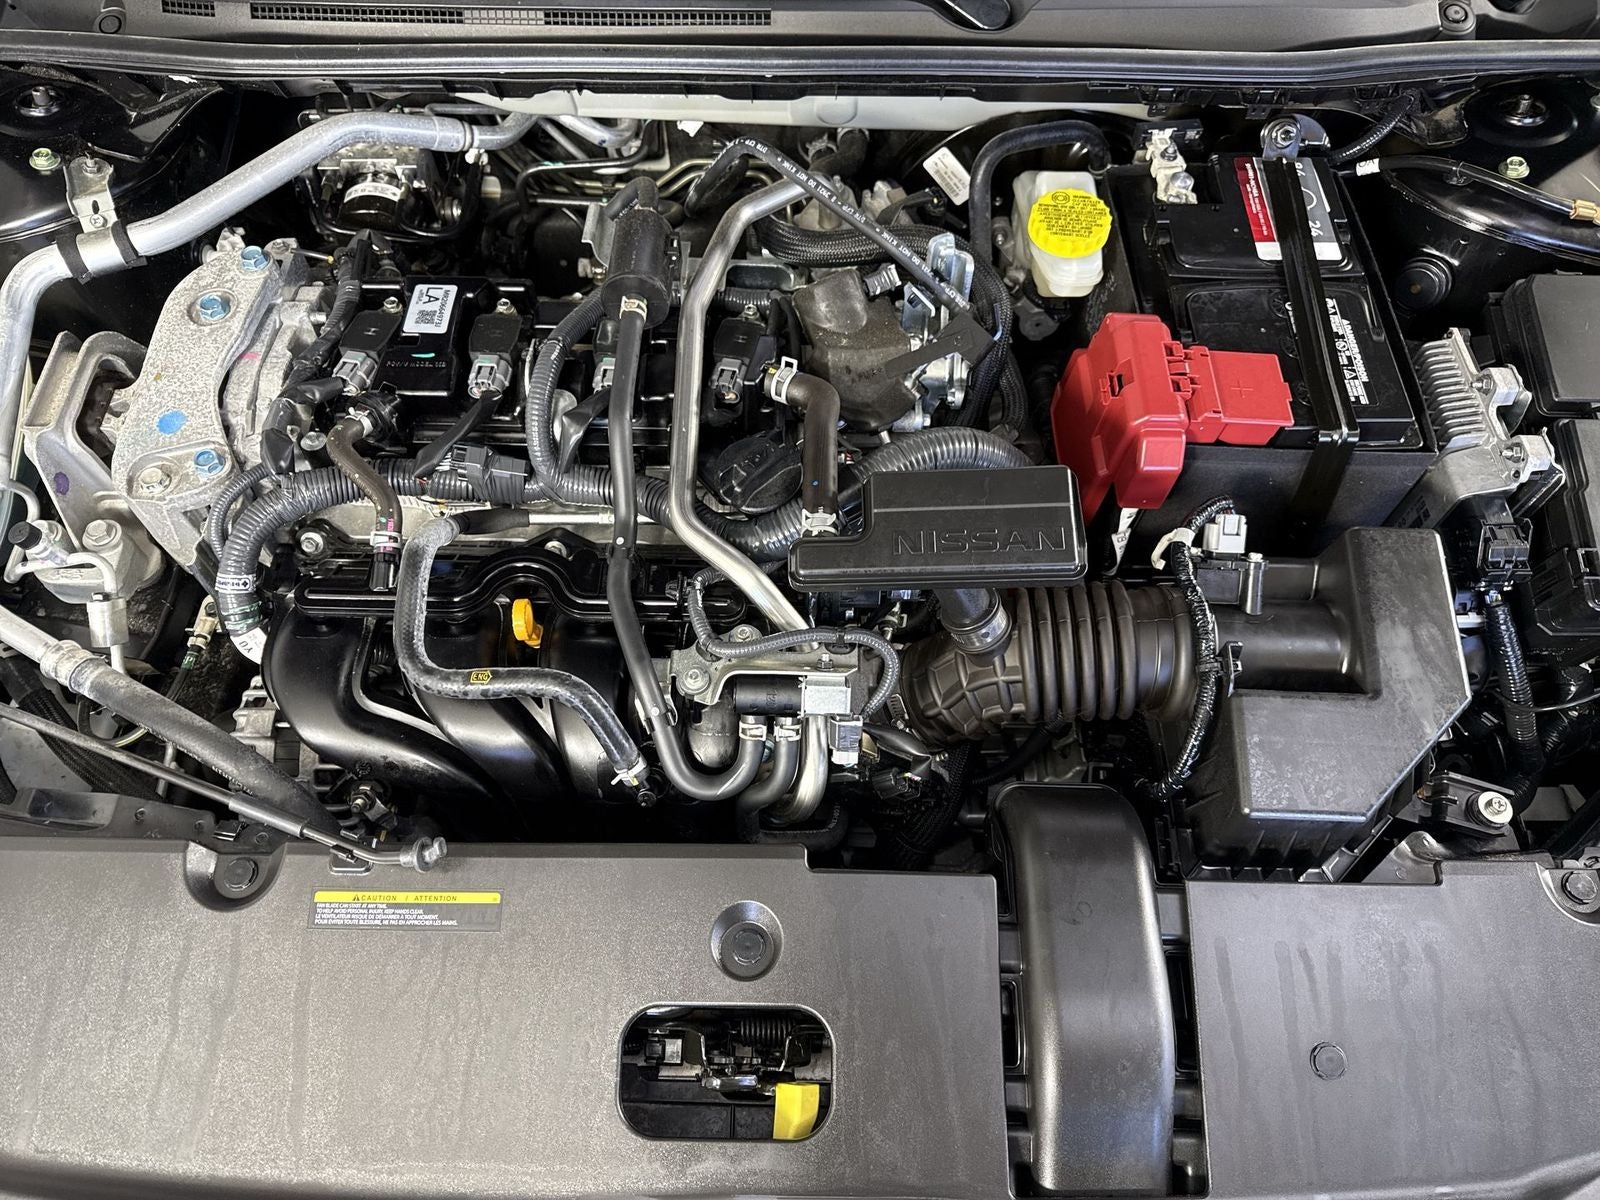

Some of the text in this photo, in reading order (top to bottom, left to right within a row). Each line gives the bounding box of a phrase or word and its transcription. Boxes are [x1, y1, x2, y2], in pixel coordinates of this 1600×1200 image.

[1308, 220, 1324, 237] 24
[422, 287, 444, 304] LA
[893, 527, 1066, 555] NISSAN
